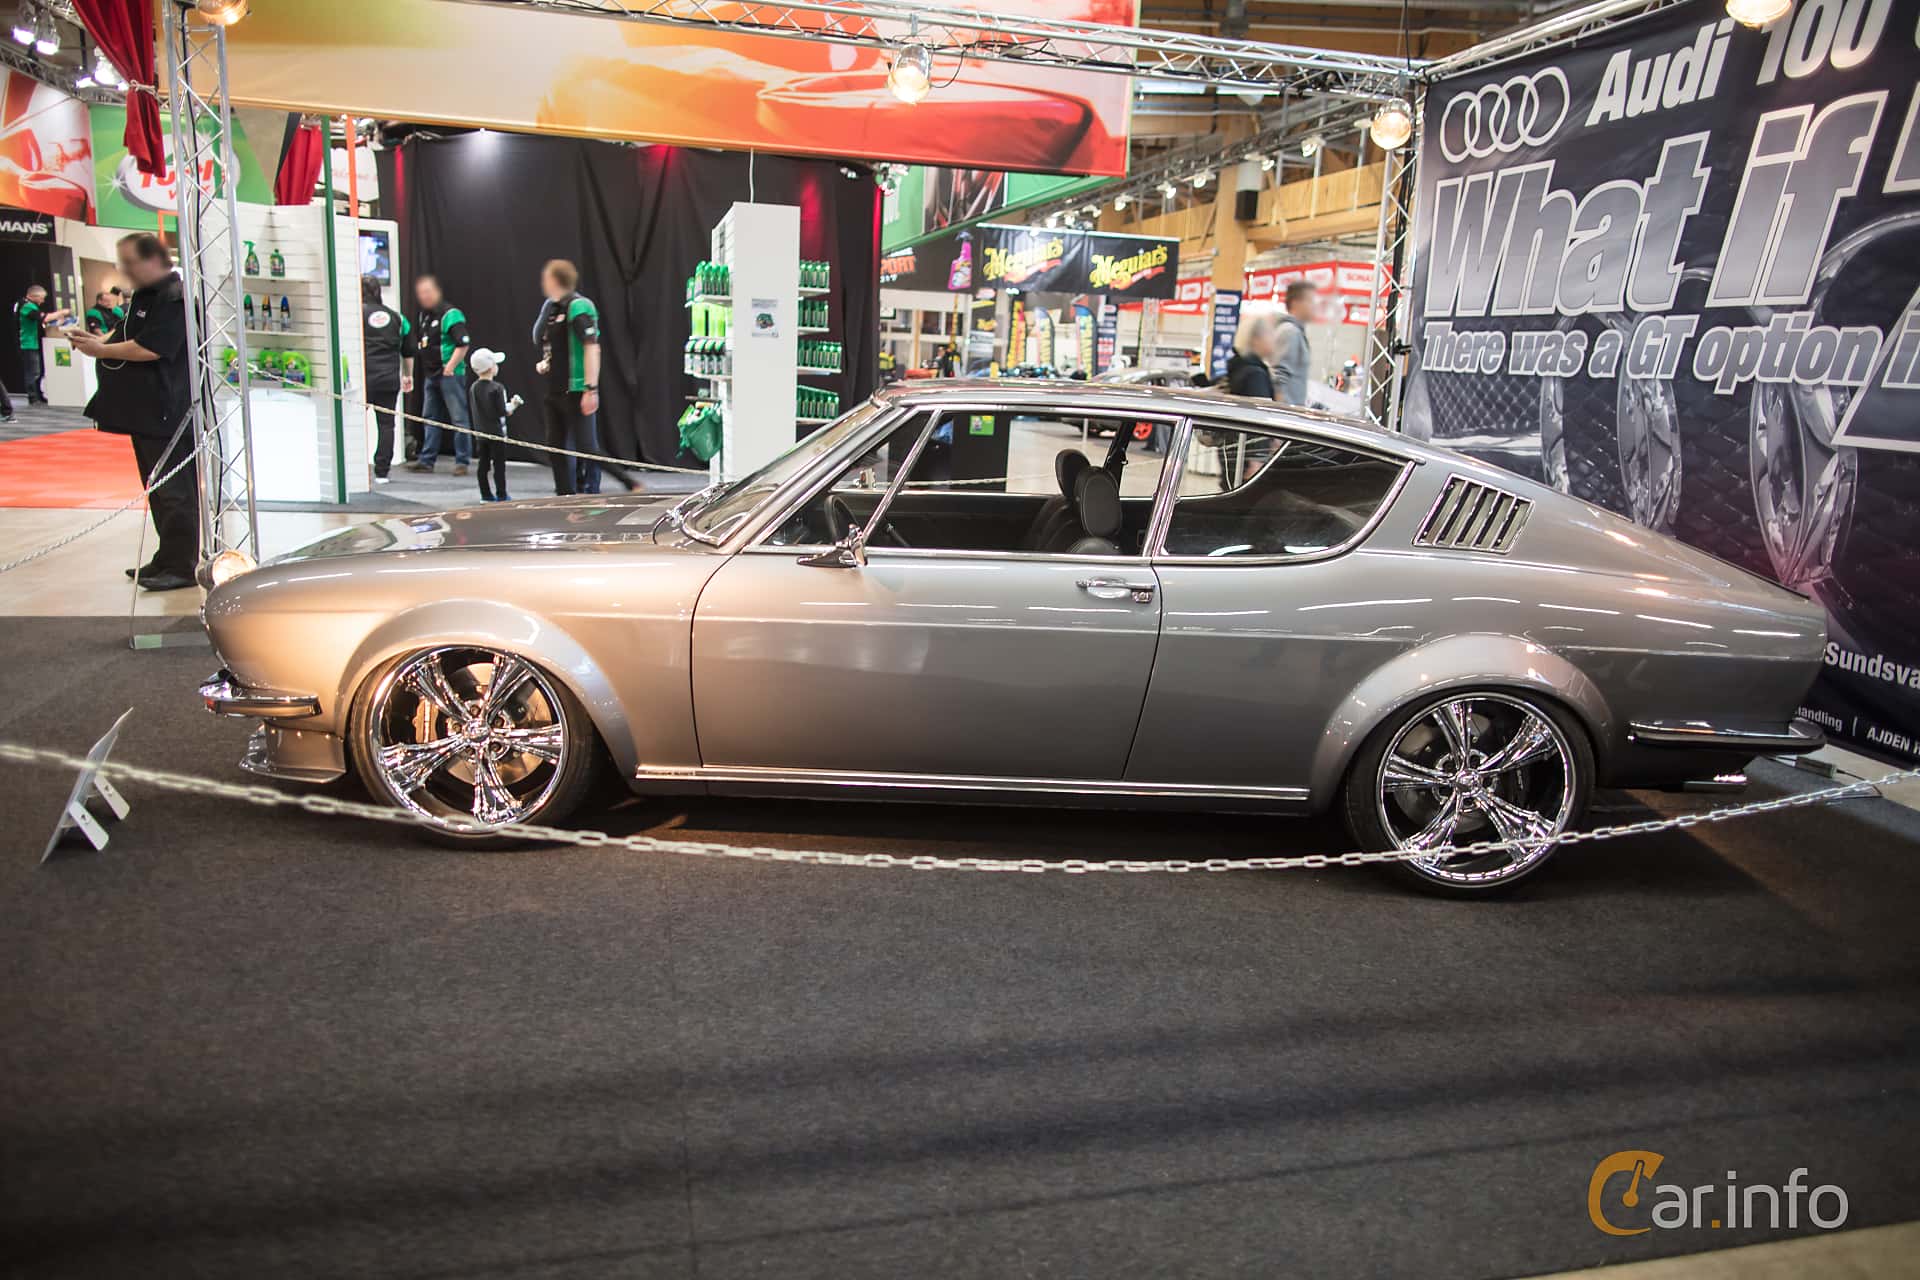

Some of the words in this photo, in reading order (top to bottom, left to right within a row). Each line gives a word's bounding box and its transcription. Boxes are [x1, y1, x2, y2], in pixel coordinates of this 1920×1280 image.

[1584, 17, 1736, 127] Audi
[1756, 0, 1894, 86] 100
[1424, 131, 1712, 316] What
[1705, 90, 1889, 307] if
[1421, 321, 1506, 376] There
[1508, 329, 1589, 378] was
[1588, 328, 1626, 379] a
[1626, 315, 1699, 380] GT
[1693, 311, 1884, 396] option
[1824, 641, 1920, 690] Sundsva
[1866, 727, 1911, 752] AJDEN
